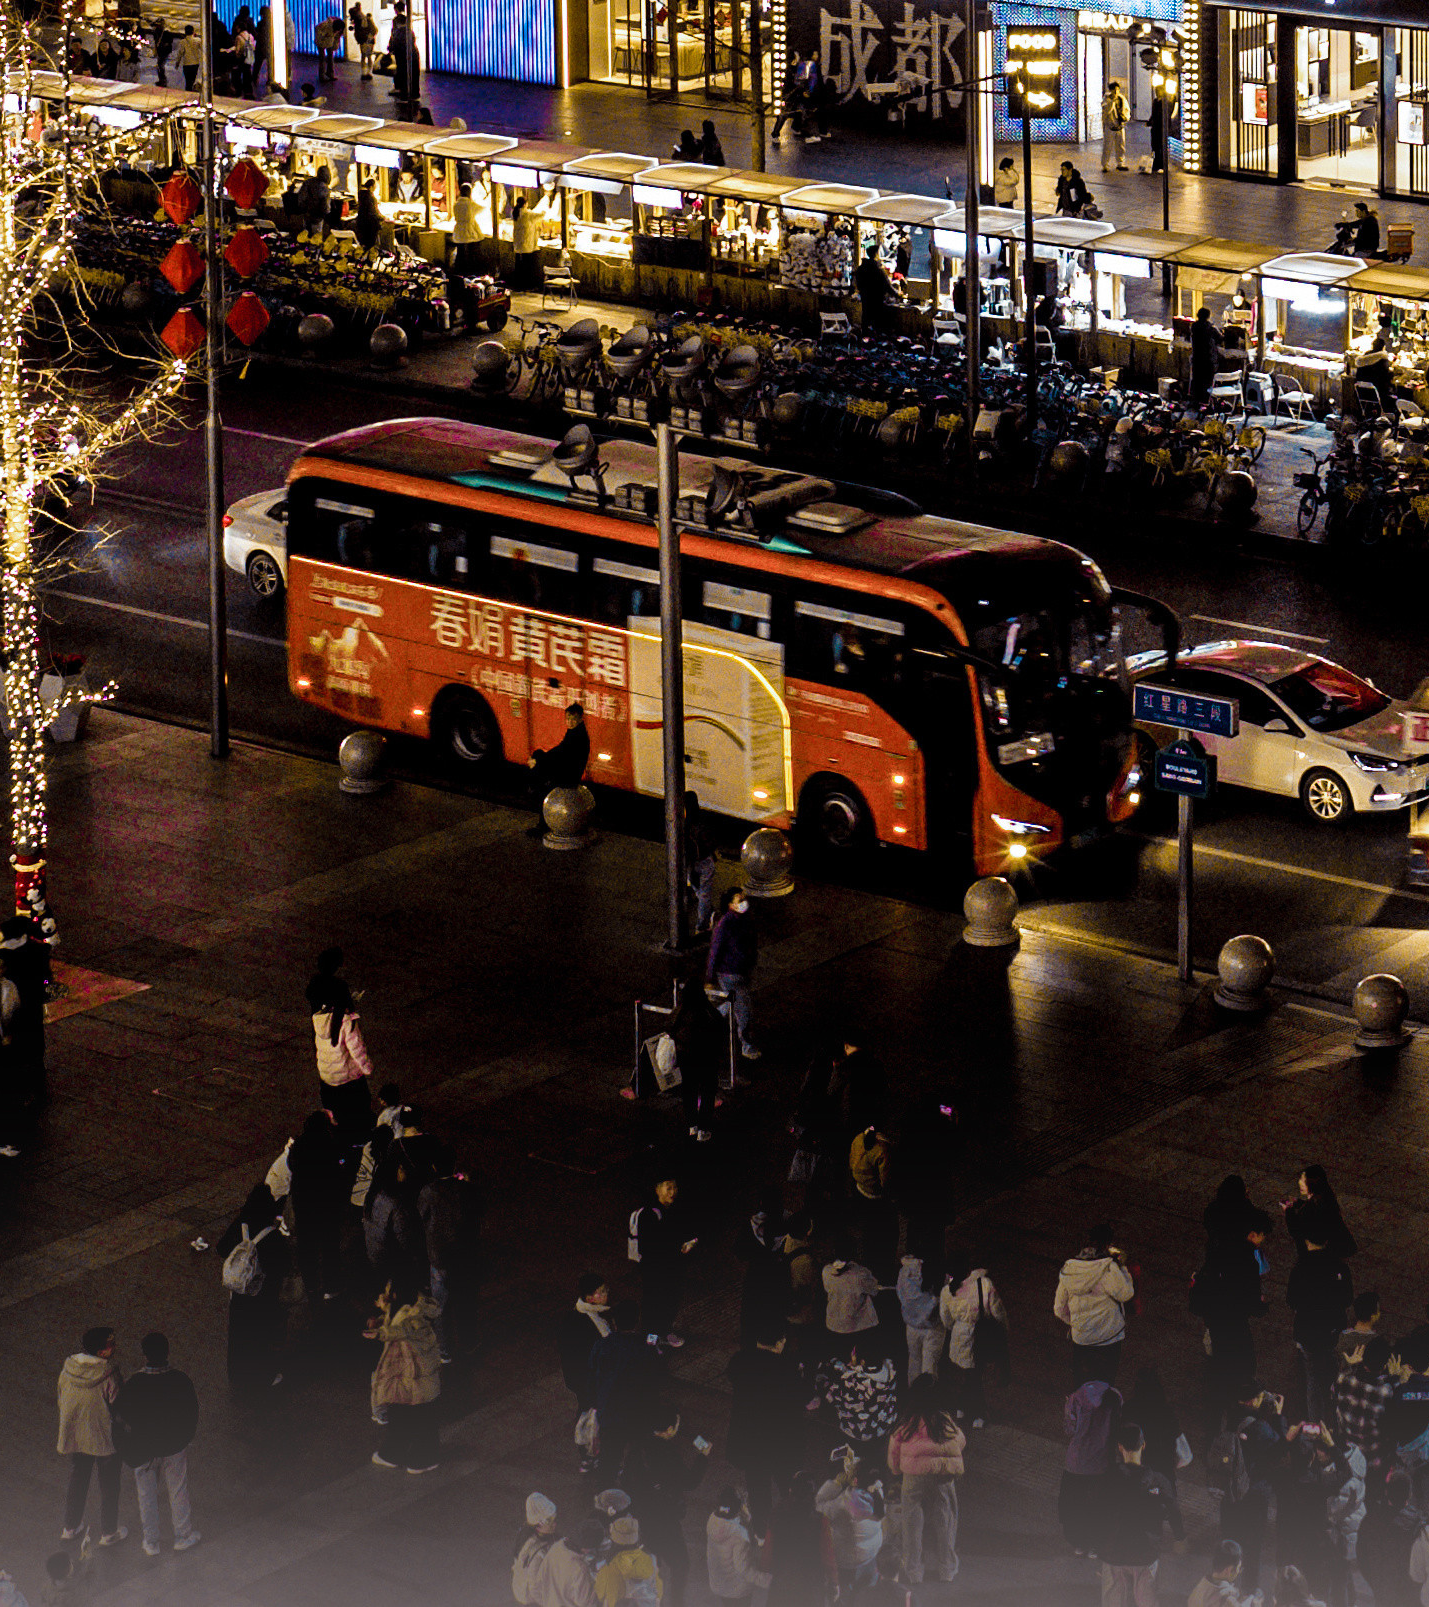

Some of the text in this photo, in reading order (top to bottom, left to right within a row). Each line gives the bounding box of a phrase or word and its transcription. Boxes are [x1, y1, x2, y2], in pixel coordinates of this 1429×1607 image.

[1143, 693, 1222, 722] 红星路三段
